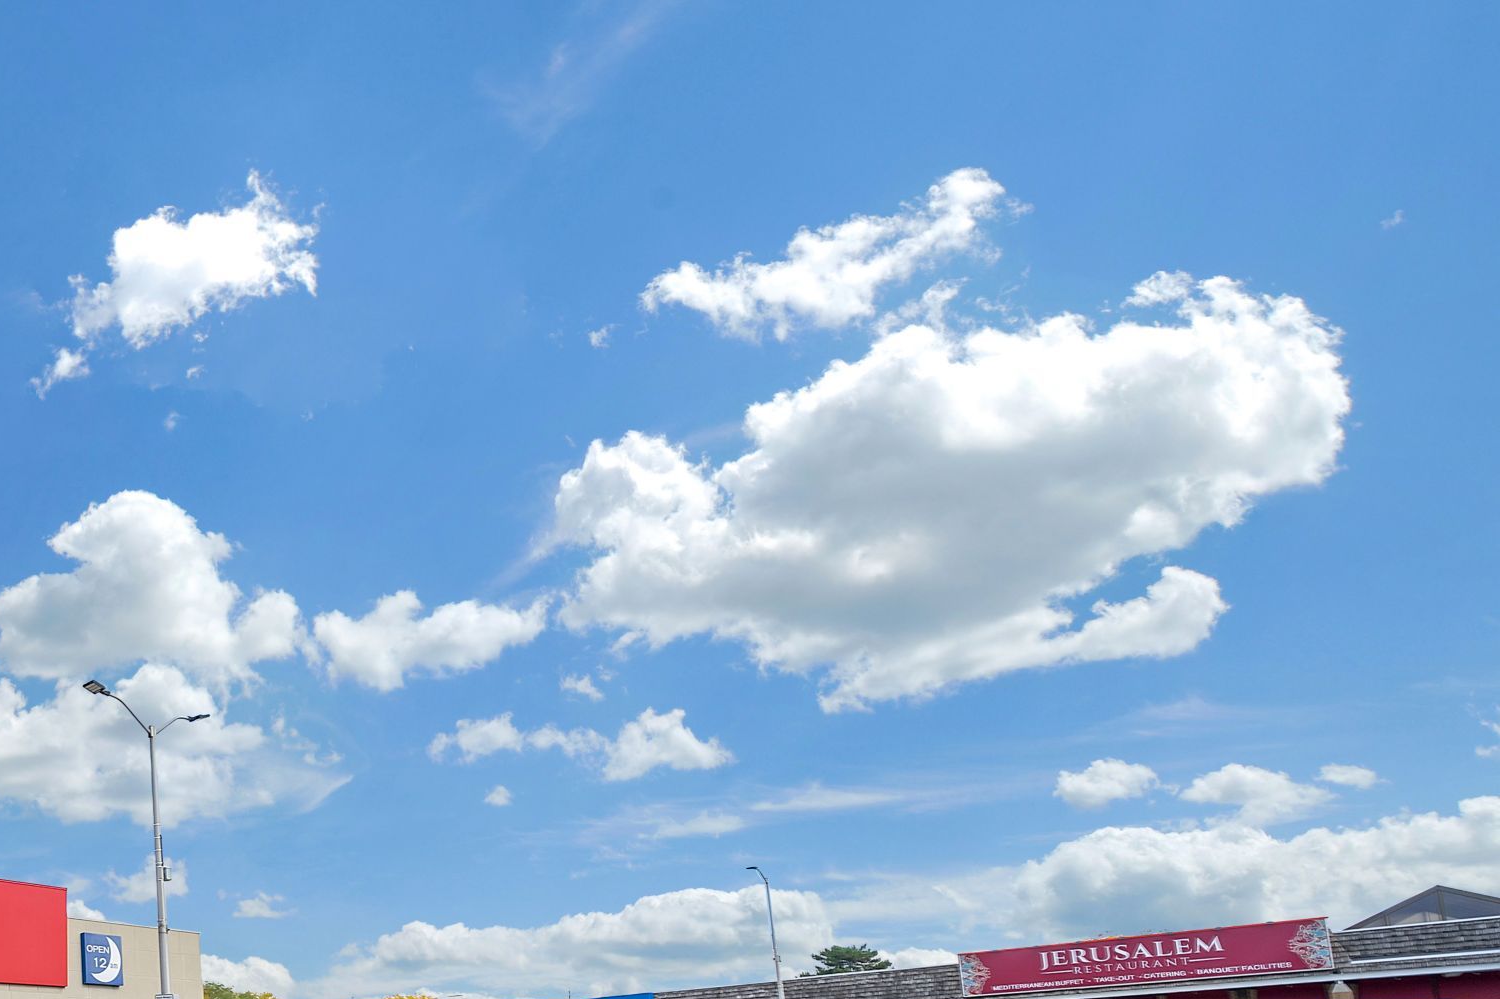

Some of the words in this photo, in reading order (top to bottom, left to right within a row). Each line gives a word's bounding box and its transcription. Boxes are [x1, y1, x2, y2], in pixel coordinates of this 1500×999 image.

[86, 944, 110, 954] OPEN
[1040, 935, 1225, 971] JERUSALEM
[94, 957, 107, 969] 12
[1073, 956, 1190, 975] RESTAURANT
[992, 981, 1054, 991] MEDITERRANEAN
[1055, 978, 1084, 987] BUFFET
[1094, 974, 1135, 983] TAKE-OUT
[1143, 970, 1187, 979] CATERING
[1197, 966, 1239, 975] BANQUET
[1241, 961, 1293, 972] FACILITIES
